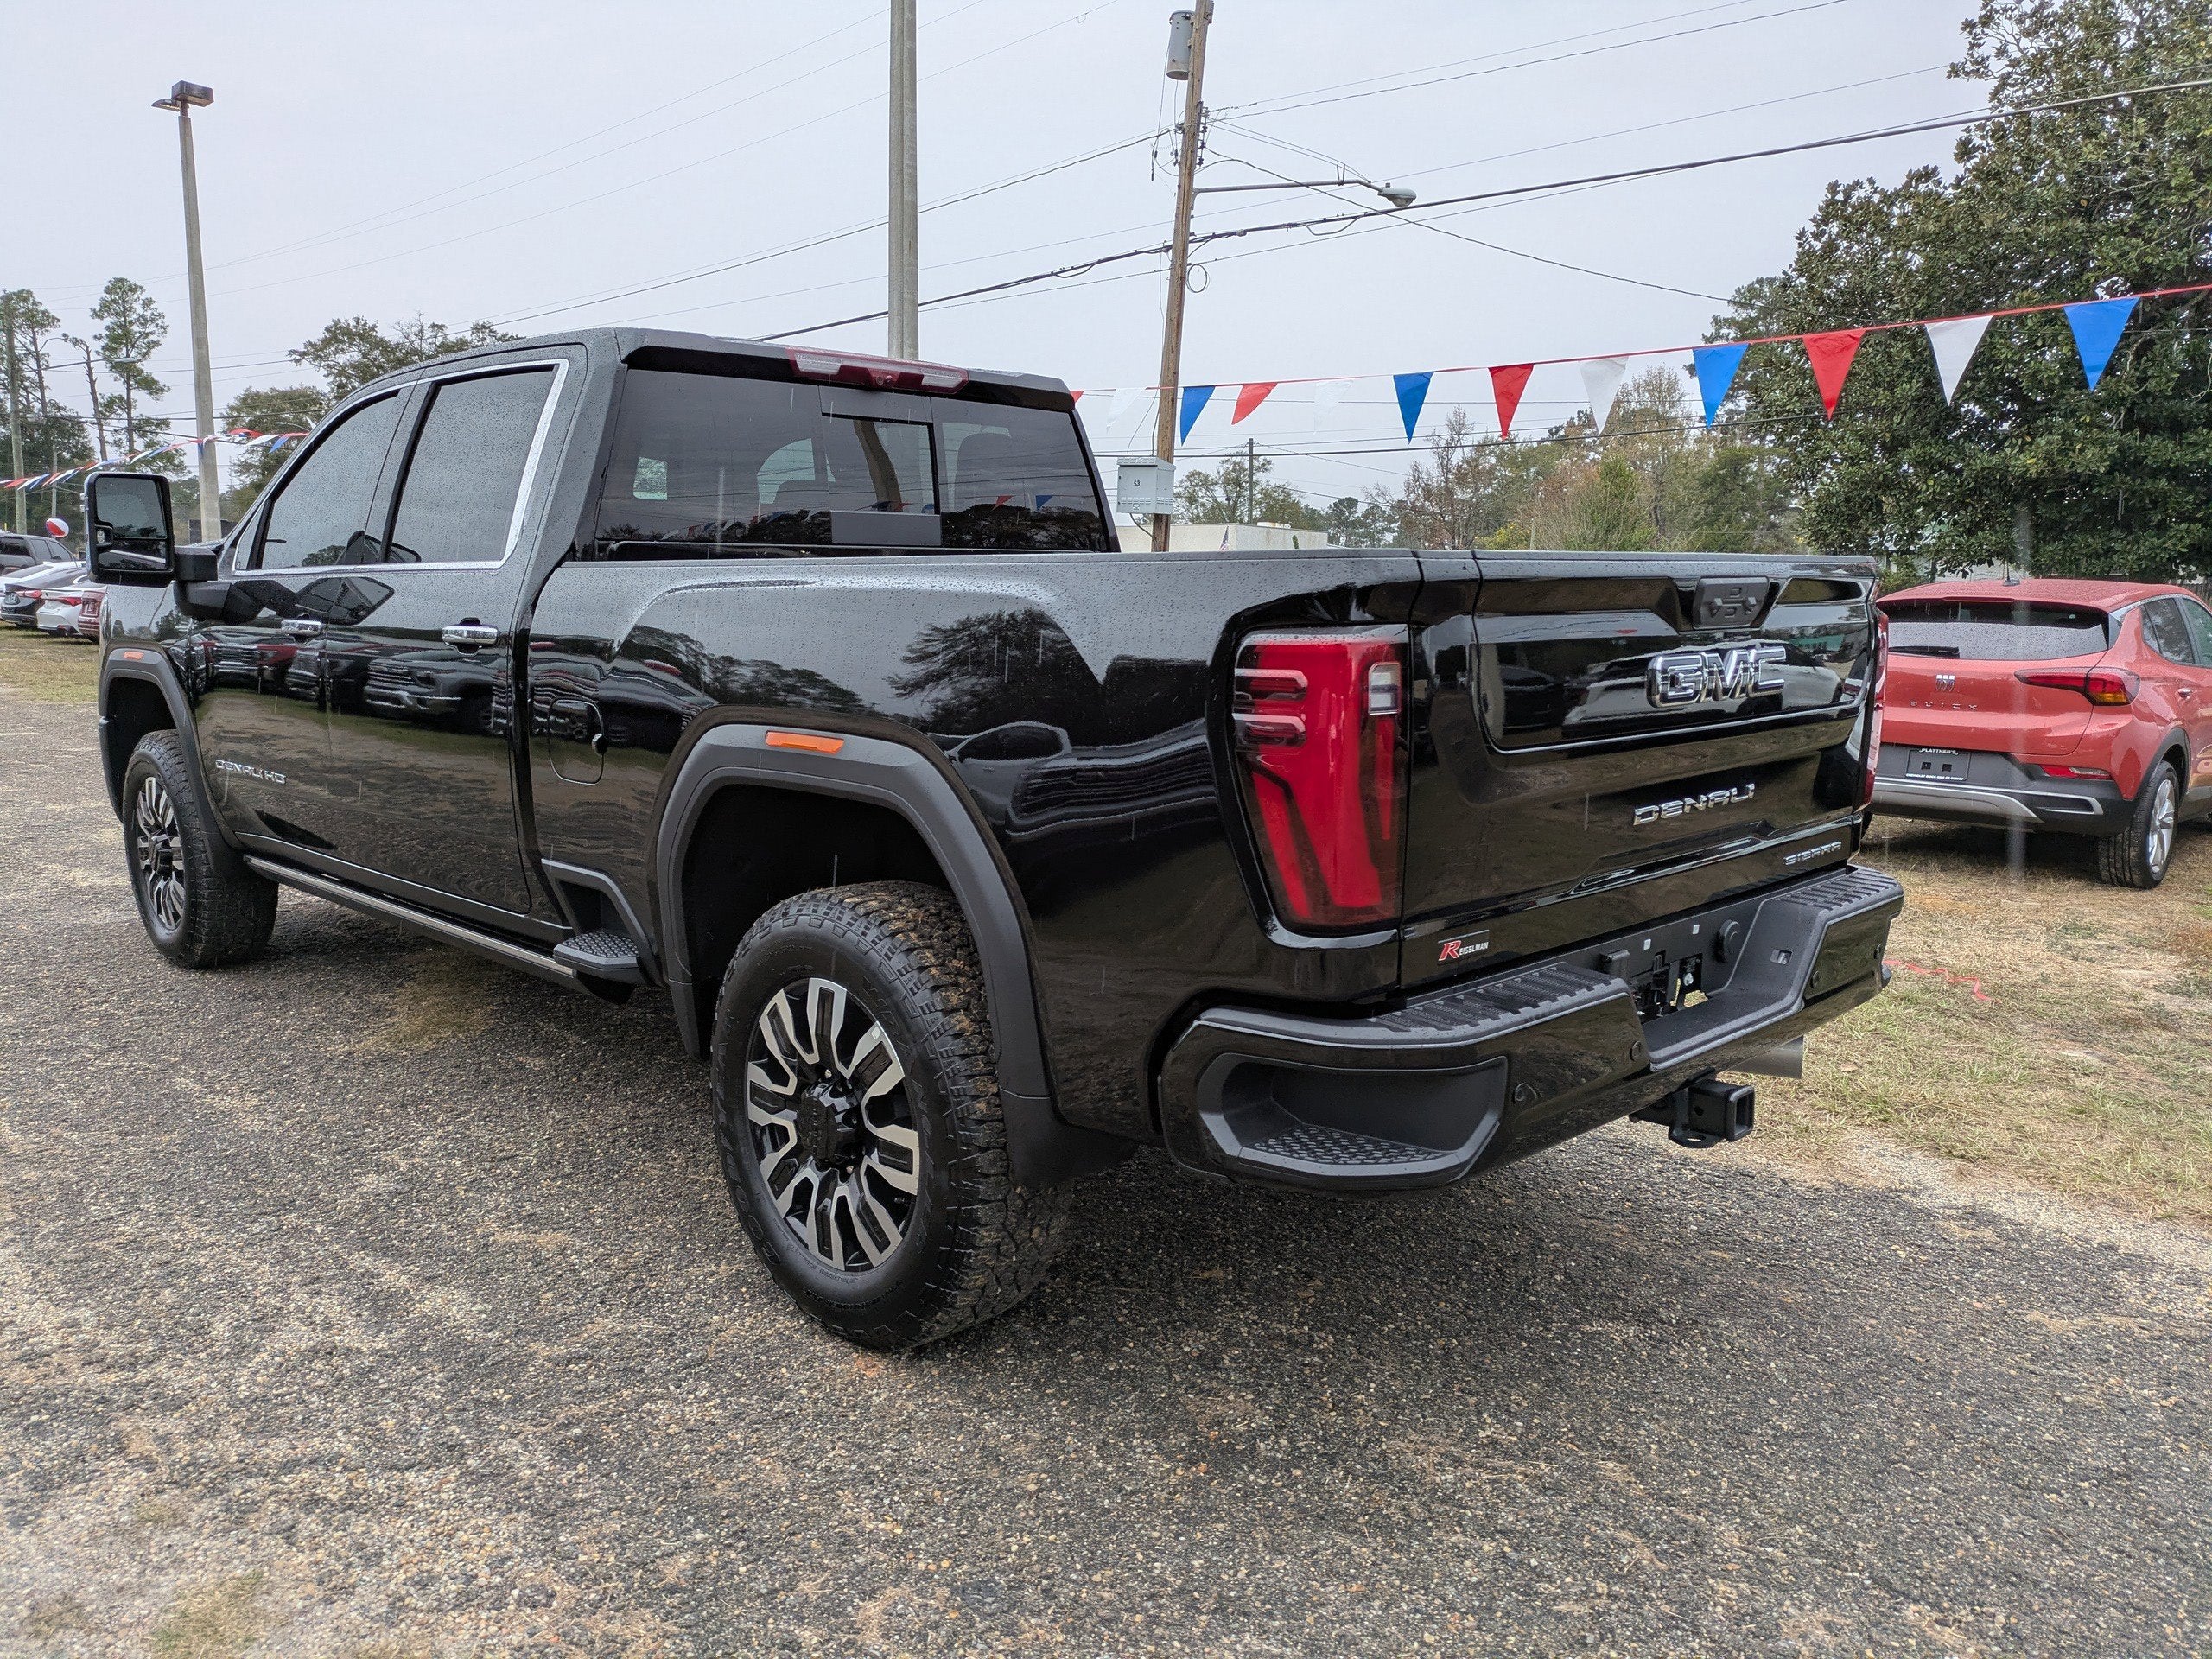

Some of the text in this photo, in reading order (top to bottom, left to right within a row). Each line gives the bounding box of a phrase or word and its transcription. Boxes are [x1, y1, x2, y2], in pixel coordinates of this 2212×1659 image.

[1646, 645, 1787, 709] GMC
[1910, 700, 1978, 711] BUICK
[215, 759, 287, 785] DENALI HD
[1633, 783, 1755, 826] DENALI
[1783, 841, 1842, 866] SIERRA
